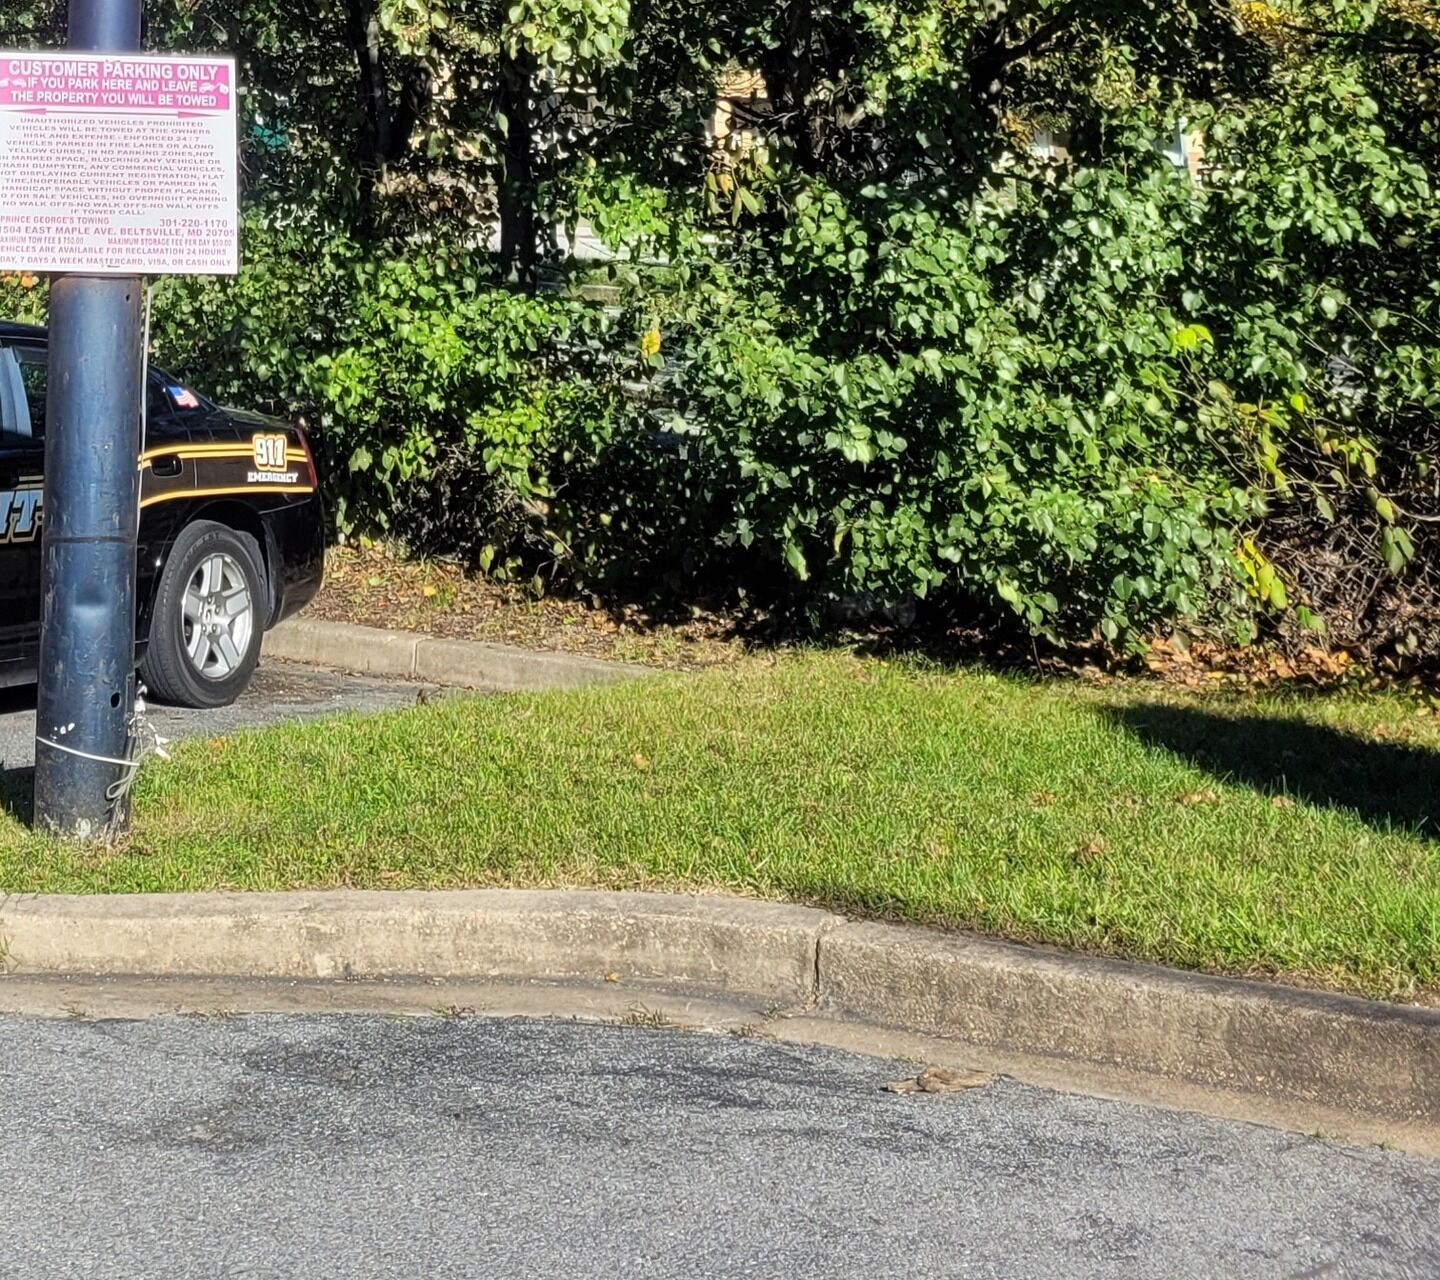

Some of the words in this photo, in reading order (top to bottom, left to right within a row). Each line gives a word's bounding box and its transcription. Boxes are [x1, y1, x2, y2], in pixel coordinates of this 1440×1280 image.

[9, 61, 99, 77] CUSTOMER
[103, 63, 173, 79] PARKING
[177, 65, 218, 80] ONLY
[28, 77, 38, 88] IF
[40, 77, 65, 89] YOU
[69, 78, 99, 90] PARK
[102, 79, 133, 90] HERE
[135, 80, 160, 91] AND
[162, 81, 197, 92] LEAVE
[11, 91, 34, 102] THE
[36, 92, 99, 103] PROPERTY
[101, 93, 125, 104] YOU
[128, 94, 155, 105] WILL
[158, 94, 174, 105] BE
[176, 95, 217, 106] TOWED
[0, 216, 31, 224] PRINCE
[33, 216, 74, 224] GEORGE'S
[77, 217, 110, 225] TOWING
[160, 219, 228, 228] 301-220-1170
[55, 227, 91, 235] MAPLE
[120, 228, 184, 238] BELTSVILLE,
[206, 229, 235, 237] 20705
[28, 236, 42, 244] TOW
[108, 237, 139, 245] MAXIMUM
[140, 238, 170, 246] STORAGE
[171, 238, 183, 246] FEE
[58, 246, 104, 254] AVAILABLE
[125, 247, 184, 255] RECLAMATION
[0, 256, 18, 264] DAY,
[86, 257, 146, 266] MASTERCARD,
[255, 438, 284, 466] 911
[247, 471, 298, 483] EMERGENCY
